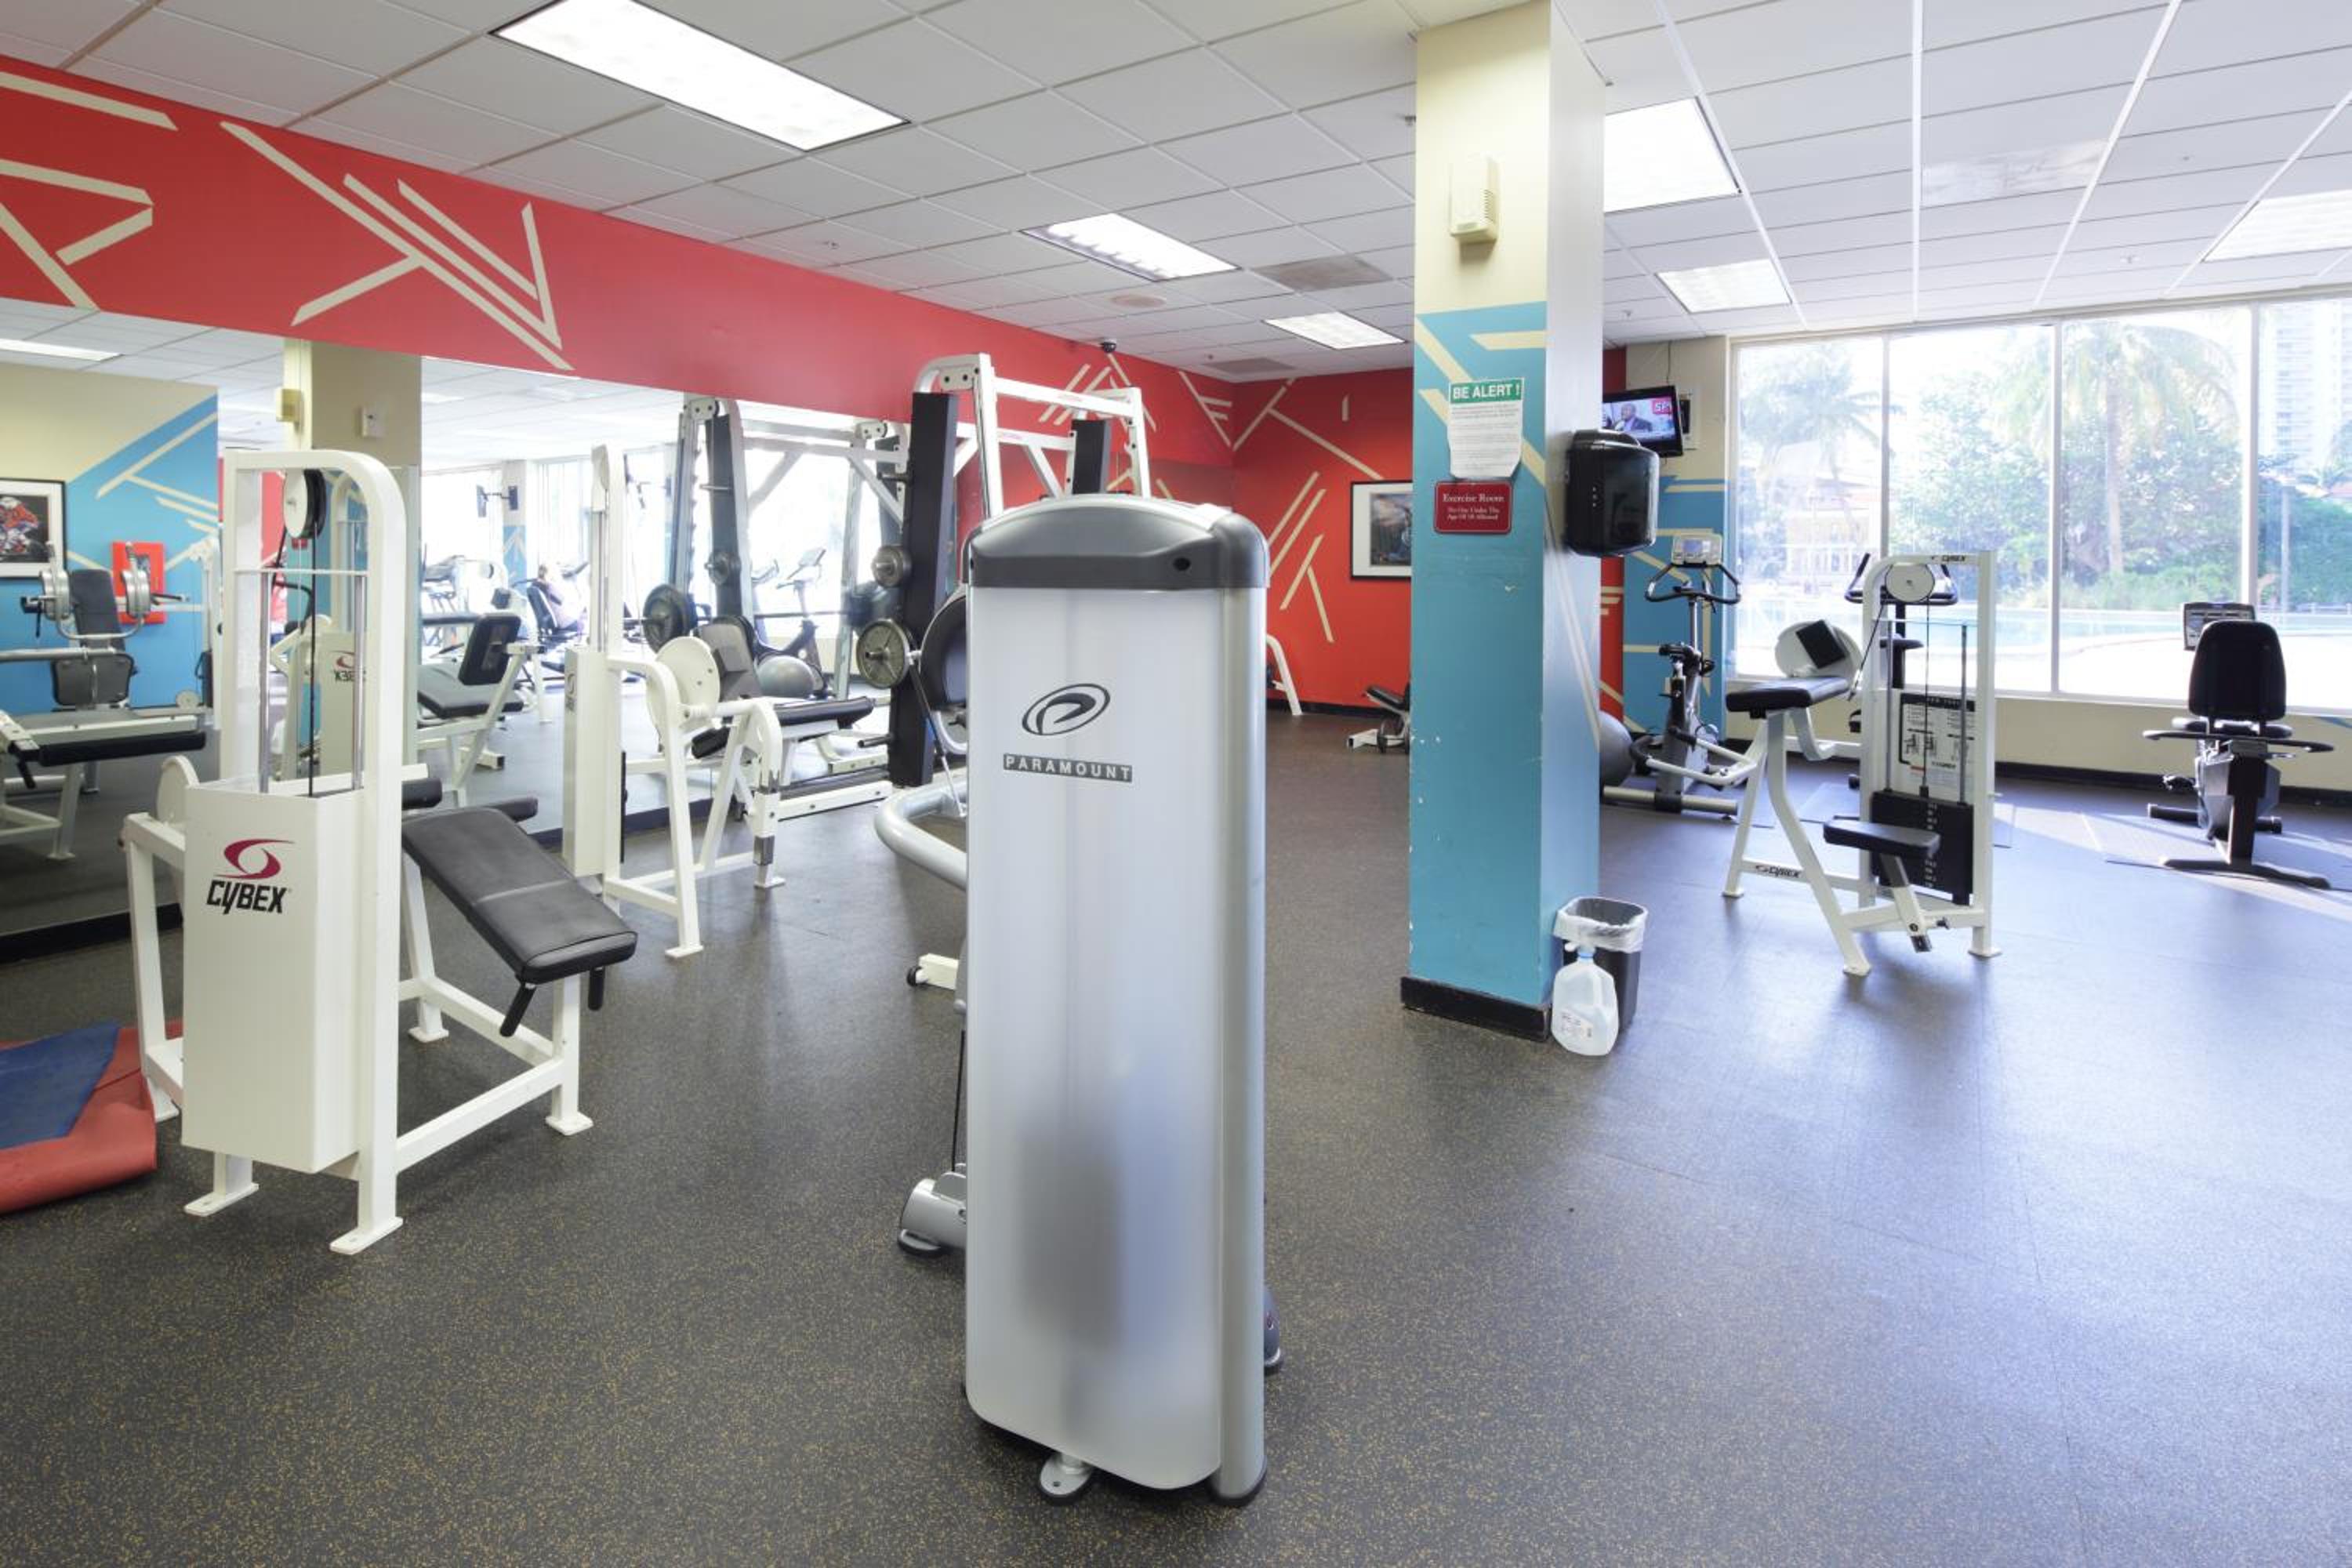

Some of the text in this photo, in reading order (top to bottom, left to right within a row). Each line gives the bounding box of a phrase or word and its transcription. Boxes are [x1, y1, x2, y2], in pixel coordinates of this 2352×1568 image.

[1453, 387, 1471, 399] BE
[1472, 384, 1513, 398] ALERT
[1443, 492, 1504, 503] Exercise Room
[1006, 754, 1131, 781] PARAMOUNT
[207, 880, 287, 915] CYBEX
